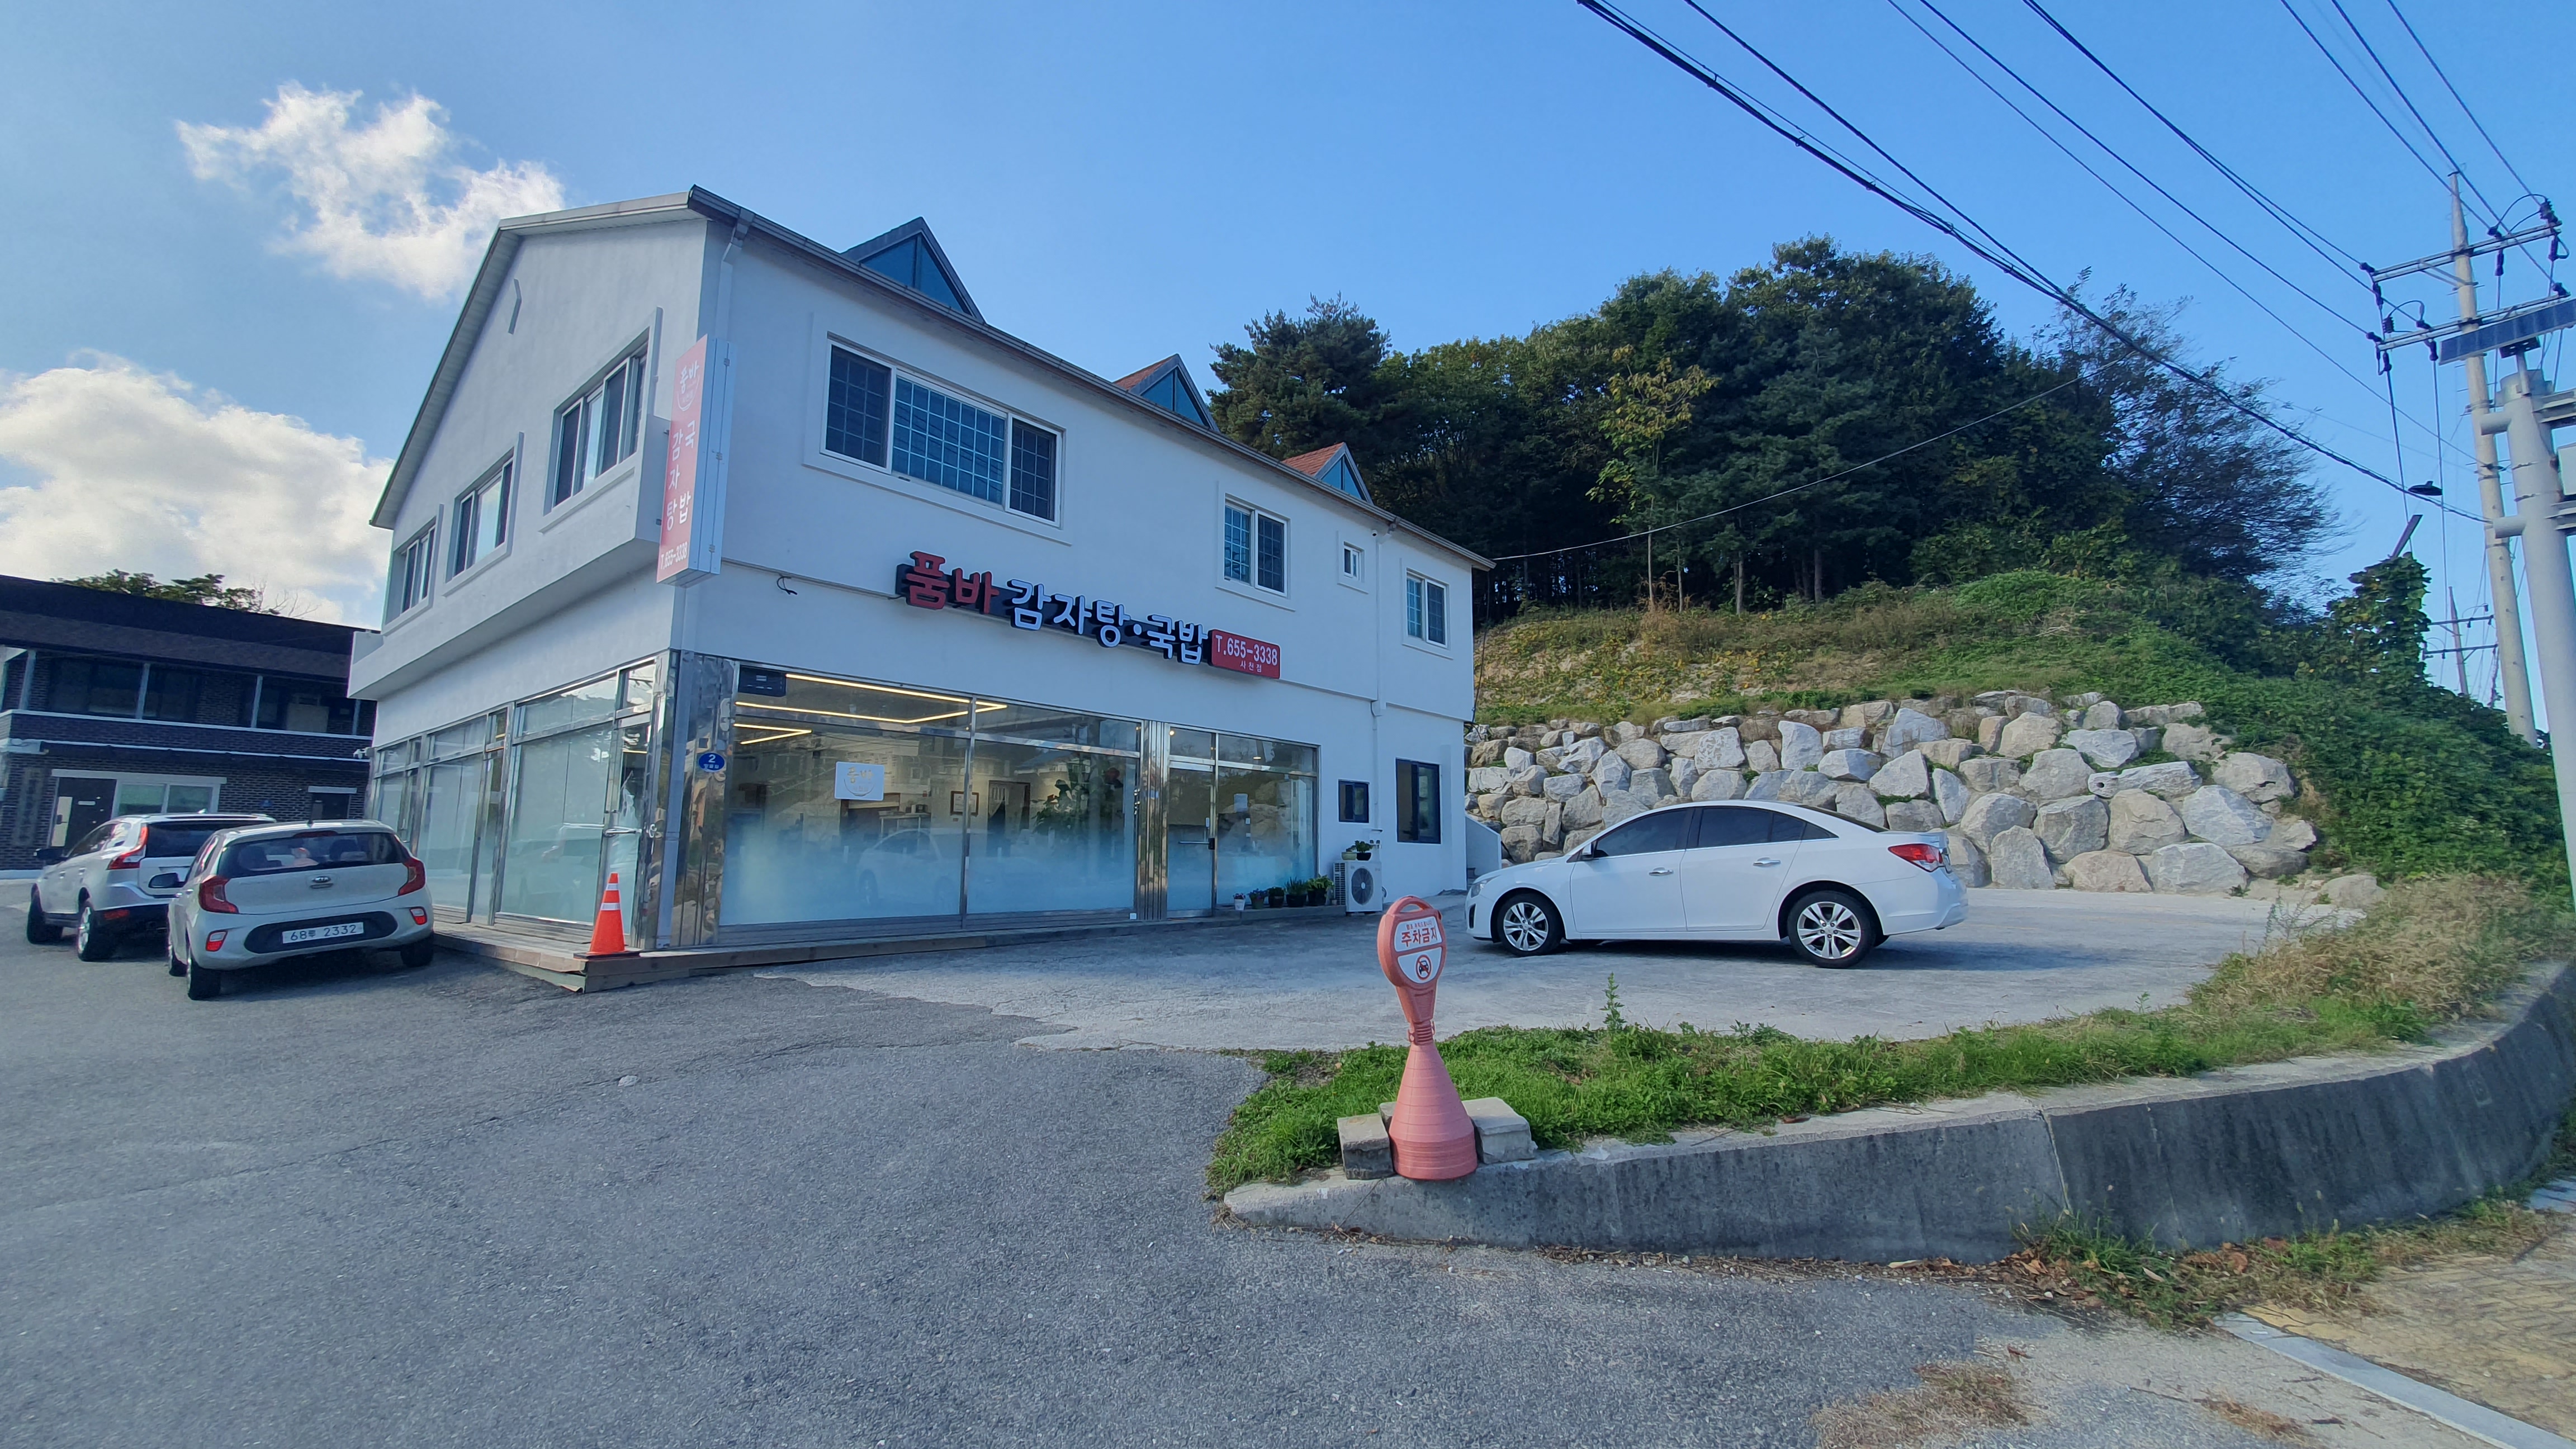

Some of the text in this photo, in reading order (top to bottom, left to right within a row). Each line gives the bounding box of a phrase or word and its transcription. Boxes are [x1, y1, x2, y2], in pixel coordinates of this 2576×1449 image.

[905, 551, 999, 614] 품바
[1215, 634, 1277, 666] T.655-3338
[708, 754, 716, 763] 2
[323, 924, 357, 937] 2332
[1401, 926, 1438, 947] 주차금지
